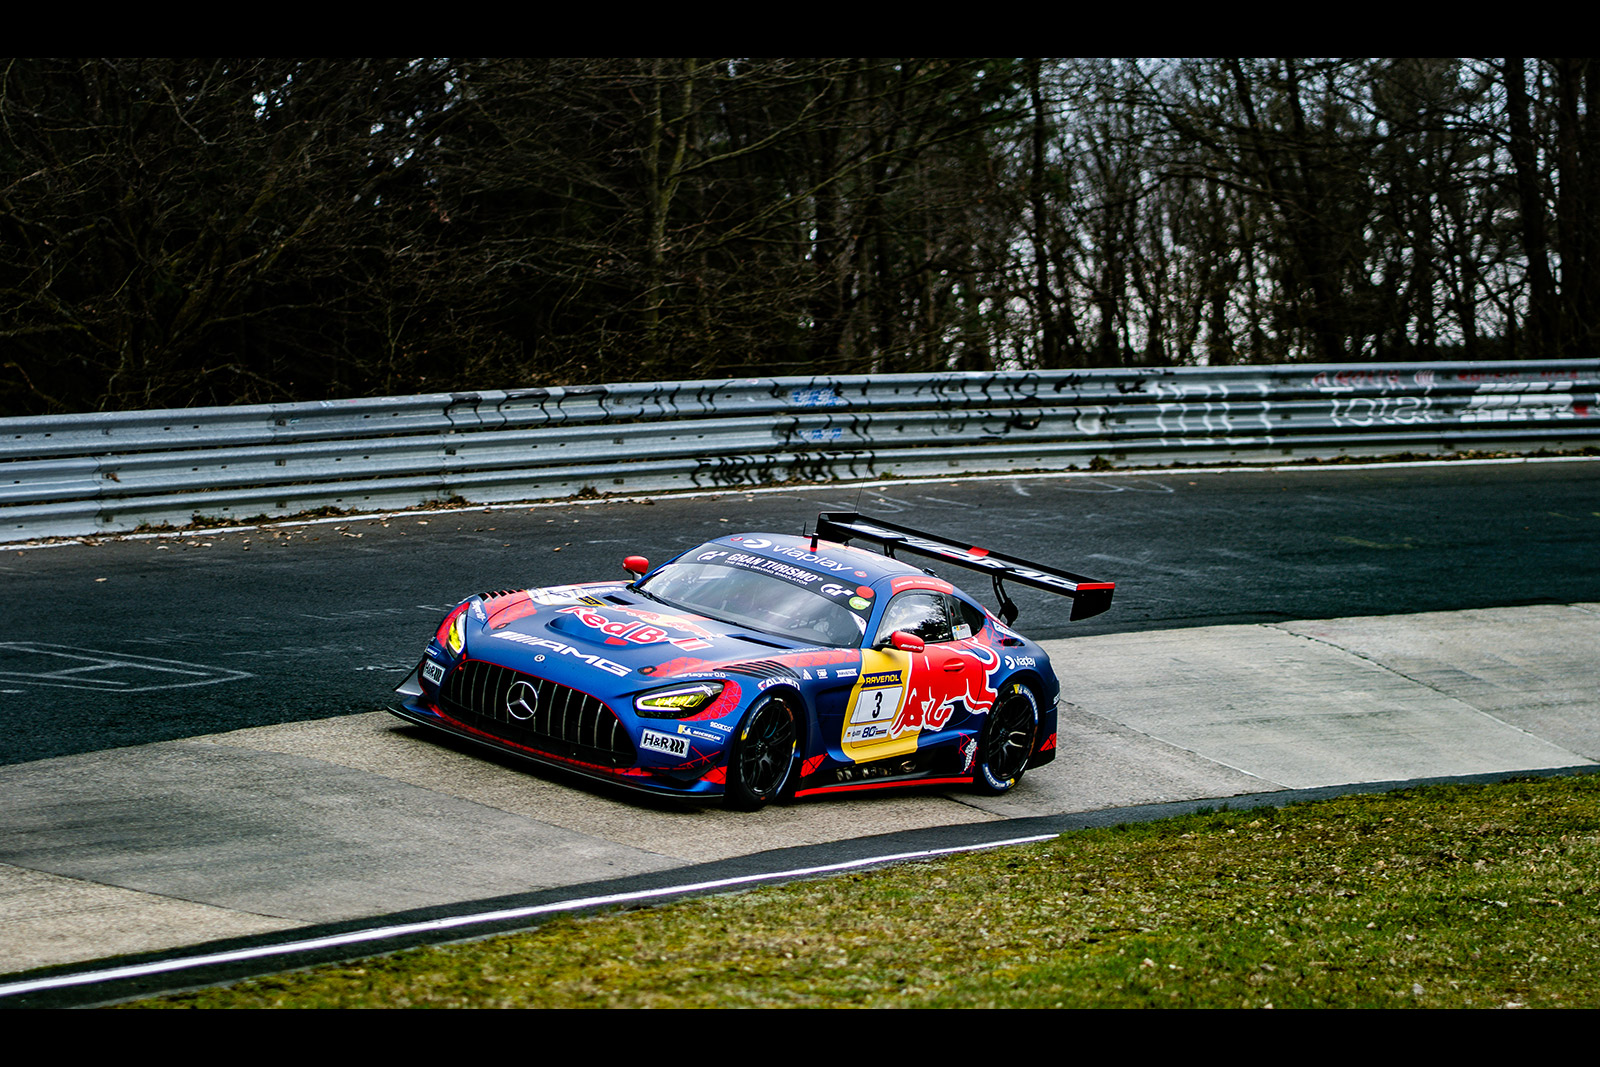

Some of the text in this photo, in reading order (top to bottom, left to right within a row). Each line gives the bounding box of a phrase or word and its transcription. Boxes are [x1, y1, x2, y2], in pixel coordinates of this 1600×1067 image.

[772, 544, 853, 572] viaplay
[727, 553, 818, 583] GRAN TURISMO
[774, 571, 808, 586] SIMULATOR
[1013, 655, 1036, 668] viaplay
[757, 676, 800, 692] FALKEN
[865, 674, 900, 684] RAVENOL
[872, 691, 883, 719] 3
[643, 733, 671, 749] H&R
